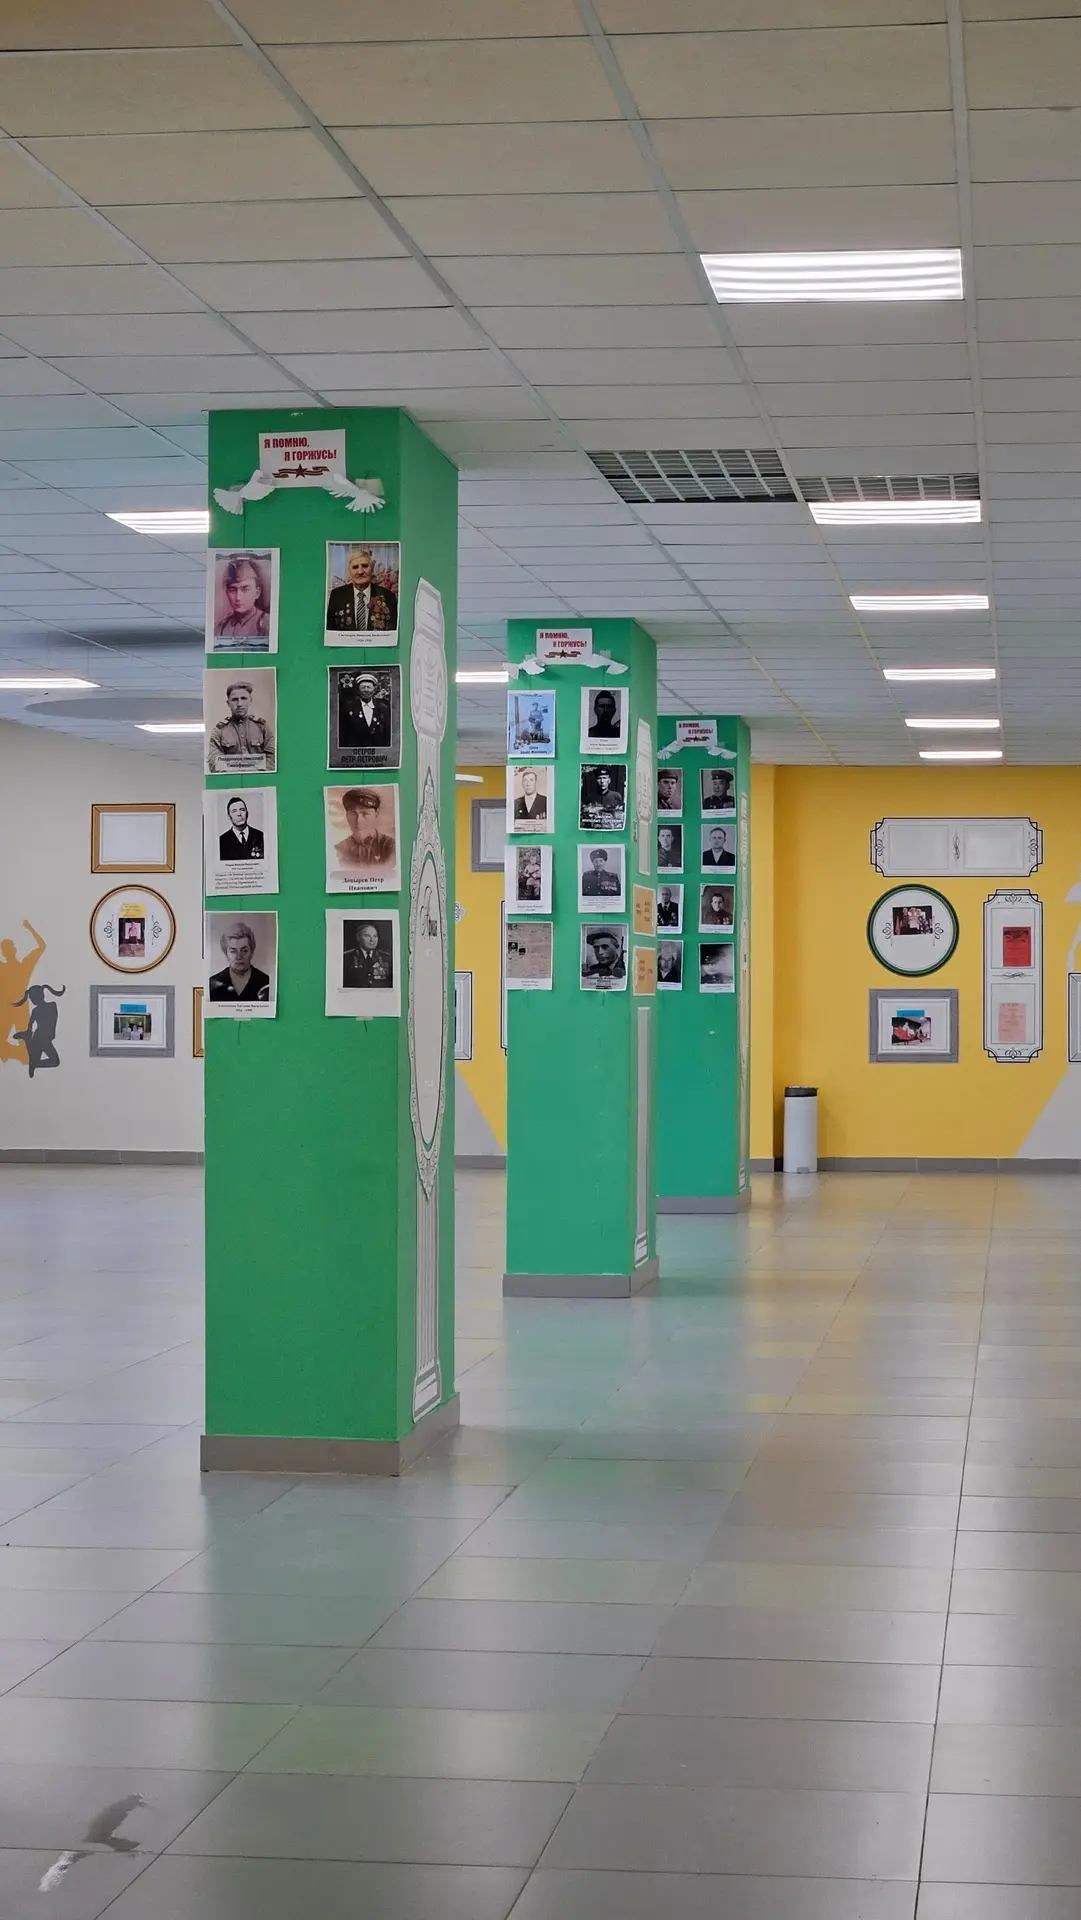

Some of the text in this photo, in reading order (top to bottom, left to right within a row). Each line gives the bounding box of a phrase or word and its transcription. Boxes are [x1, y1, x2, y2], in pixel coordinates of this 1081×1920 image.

[264, 437, 309, 448] Я ПОМНЮ,
[284, 450, 337, 461] Я ГОРЖУСЬ!
